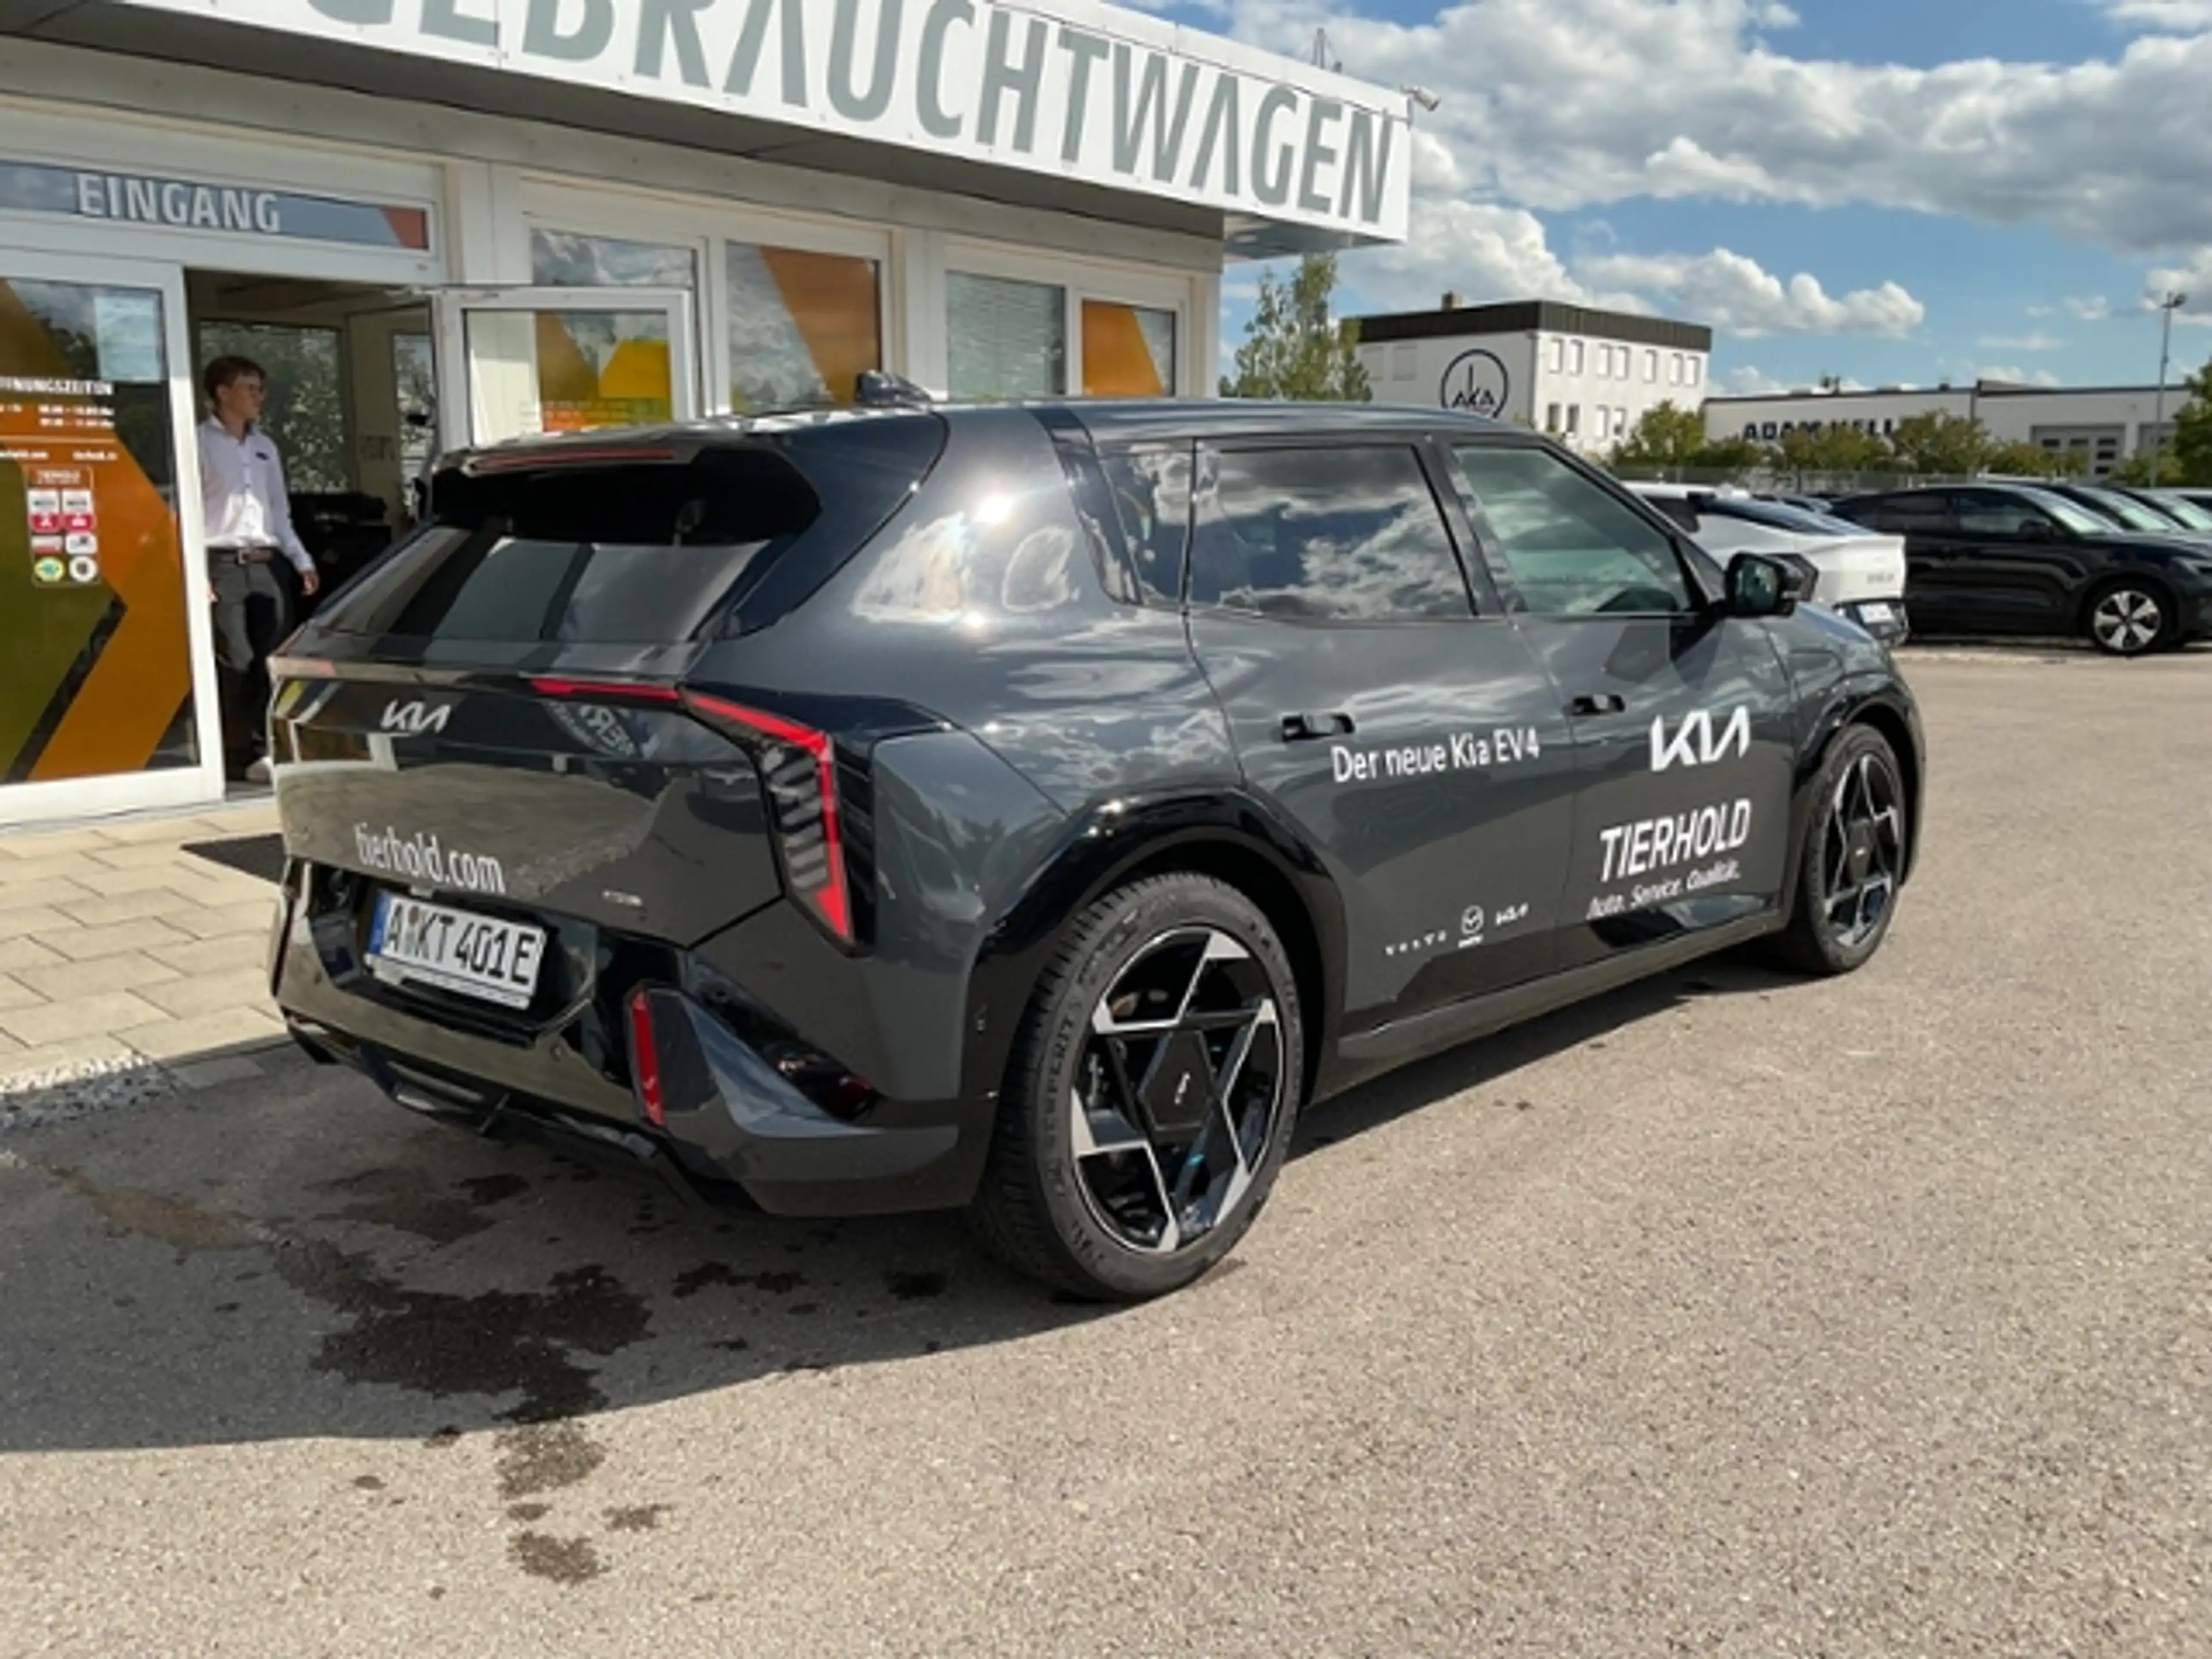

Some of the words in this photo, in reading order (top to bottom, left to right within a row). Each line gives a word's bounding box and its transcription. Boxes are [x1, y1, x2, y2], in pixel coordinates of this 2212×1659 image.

[77, 173, 281, 233] EINGANG
[1331, 745, 1380, 783] Der
[1385, 745, 1446, 776] neue
[1449, 732, 1491, 769] Kia
[354, 822, 506, 895] tierhold.com
[1599, 798, 1752, 882] TIERHOLD
